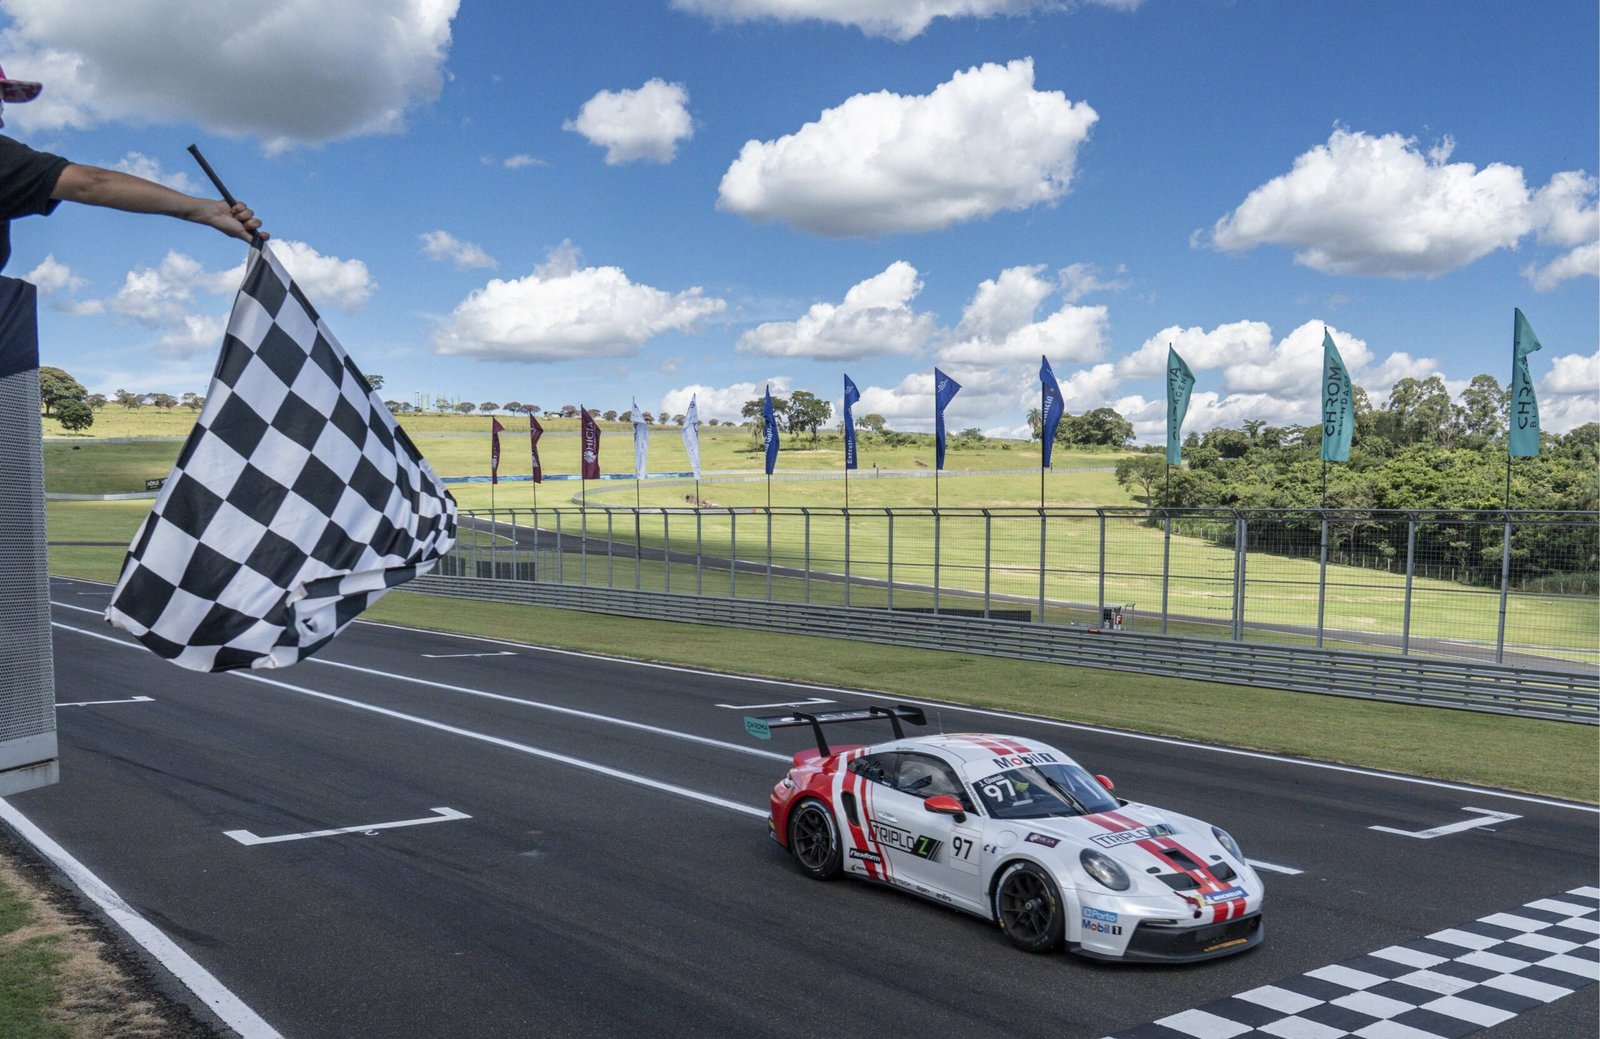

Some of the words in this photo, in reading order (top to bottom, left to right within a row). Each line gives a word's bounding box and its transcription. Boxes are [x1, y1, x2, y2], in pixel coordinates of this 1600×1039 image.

[992, 753, 1041, 769] Mobil
[1041, 752, 1058, 763] 1
[983, 778, 1017, 803] 97
[872, 825, 916, 852] TRIPLO
[918, 836, 929, 856] Z
[1096, 829, 1152, 845] TRIPLO
[952, 836, 973, 860] 97
[1090, 908, 1116, 922] Porto
[1081, 919, 1110, 934] Mobil
[1112, 926, 1122, 936] 1
